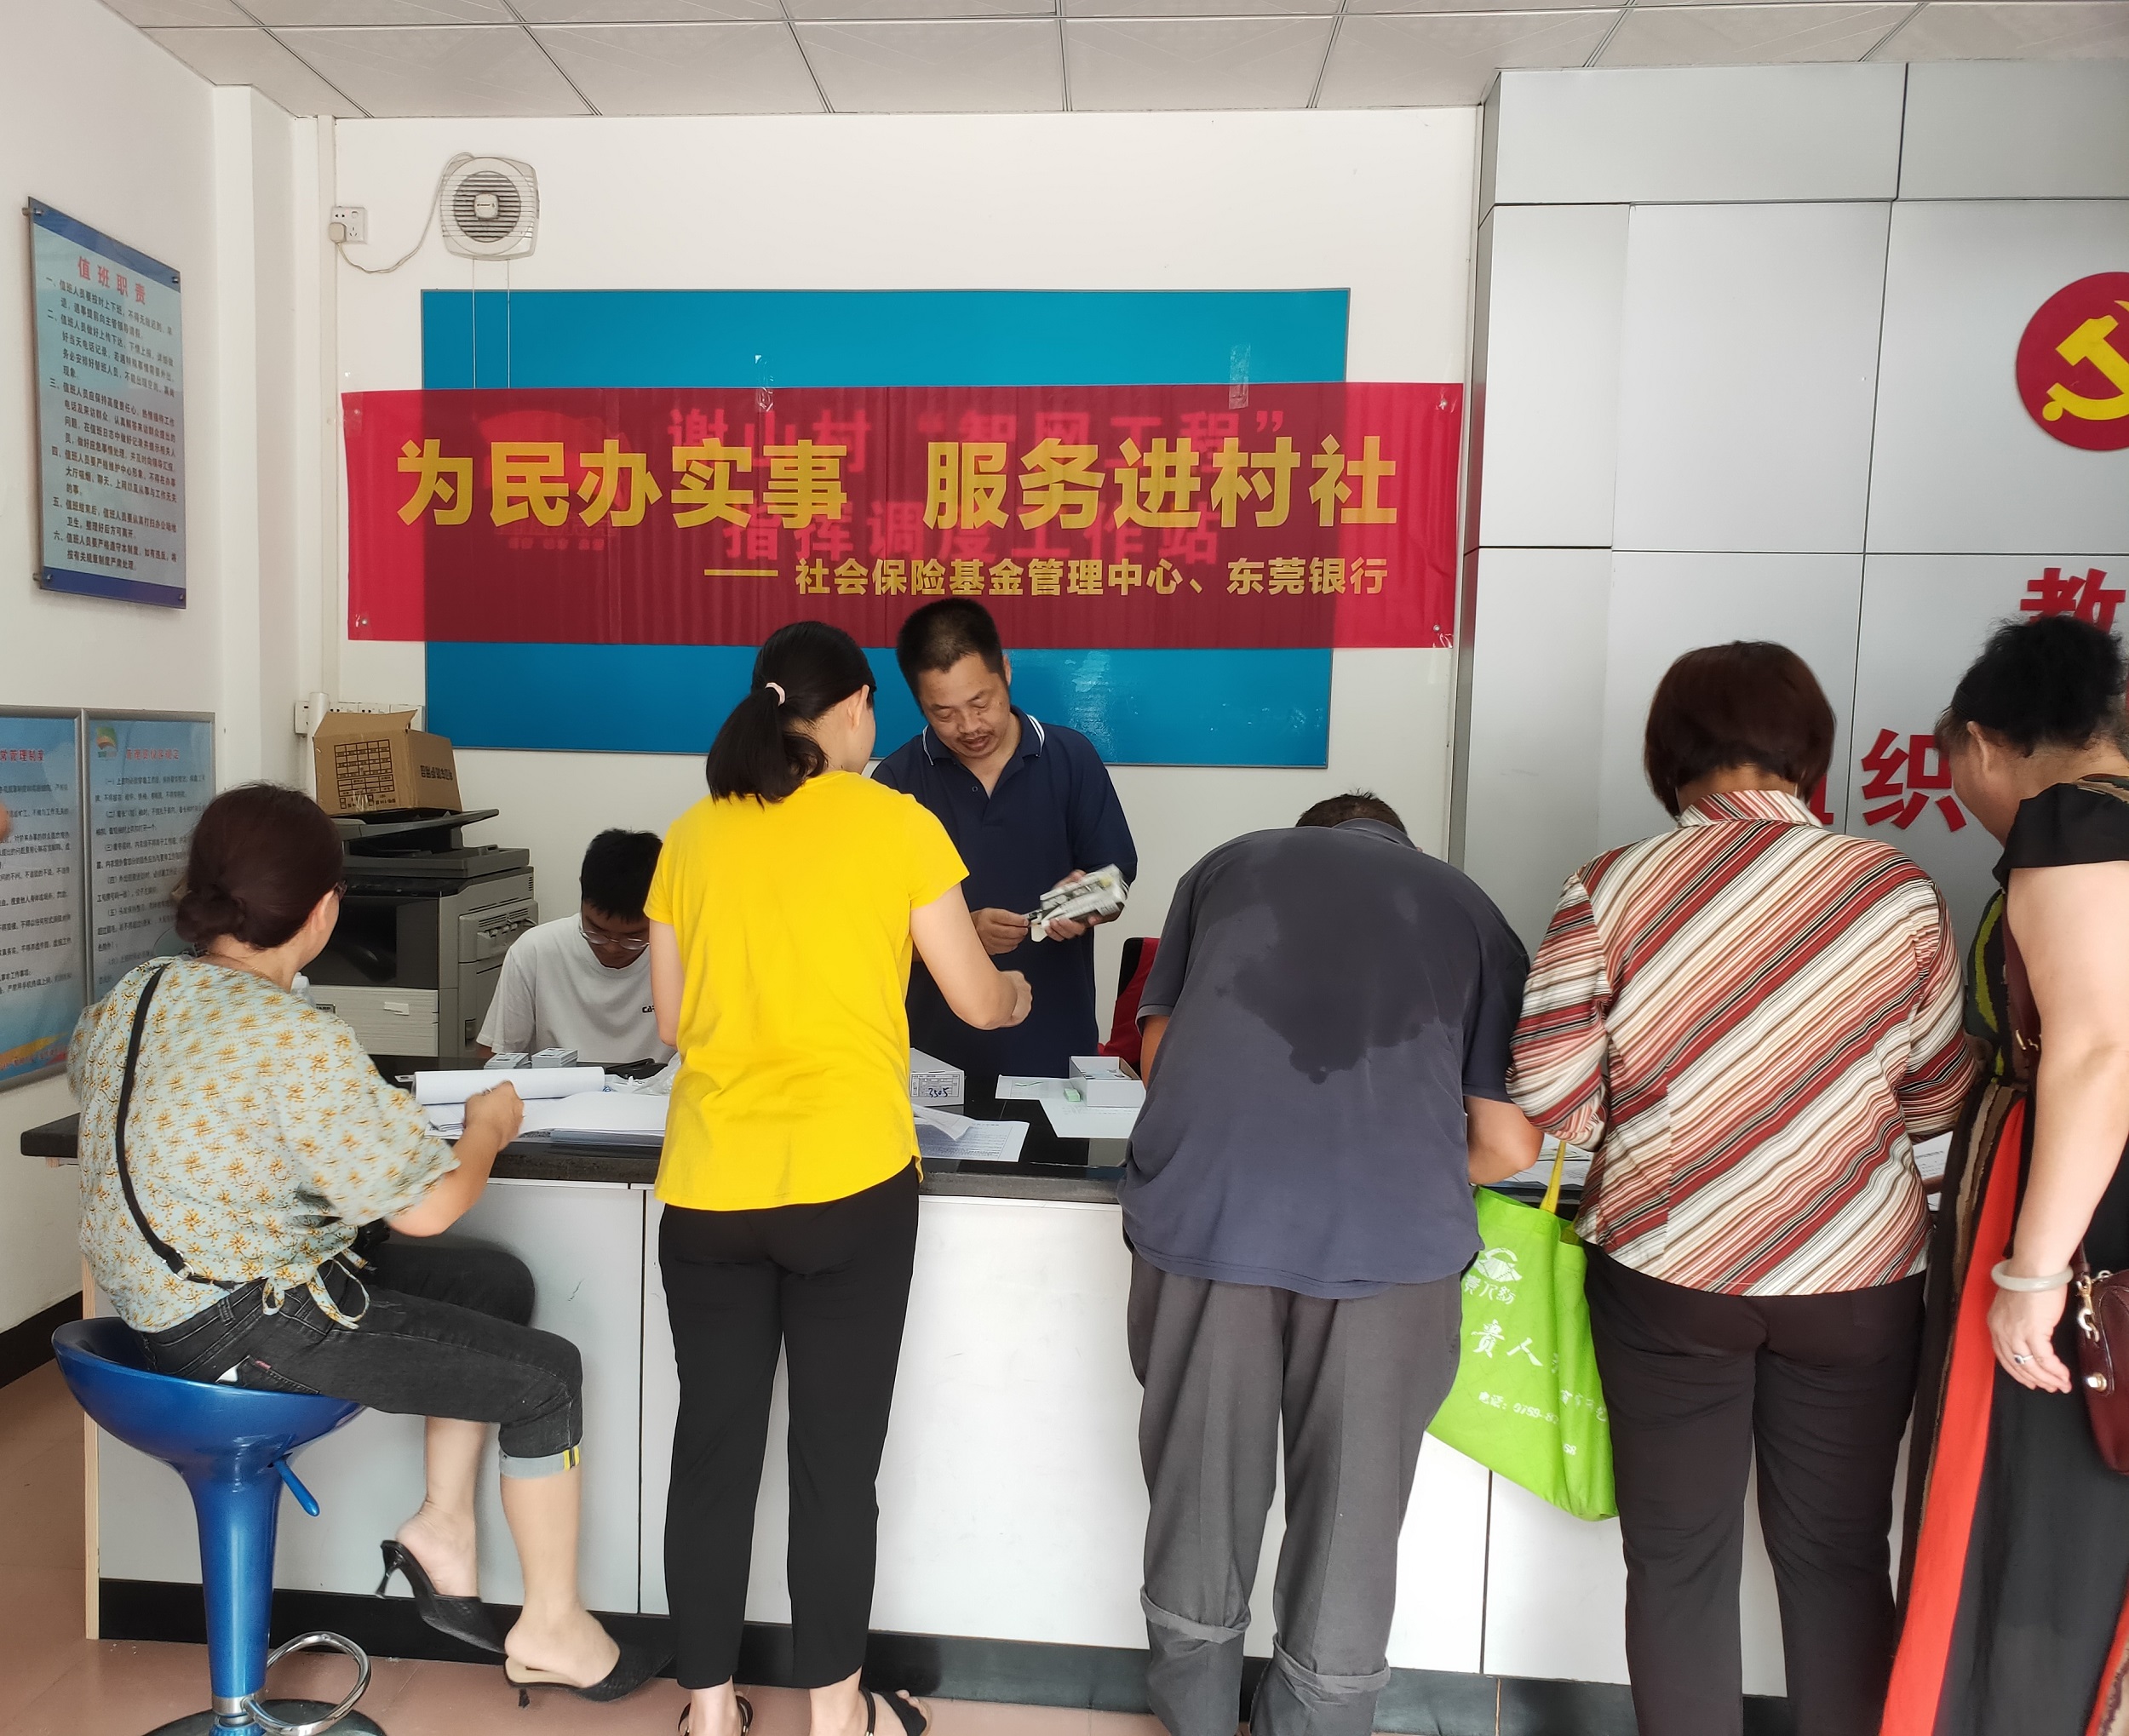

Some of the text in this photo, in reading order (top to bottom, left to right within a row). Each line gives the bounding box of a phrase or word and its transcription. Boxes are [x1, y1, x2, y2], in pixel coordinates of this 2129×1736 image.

[77, 255, 146, 306] 值班职责
[397, 434, 1397, 530] 为民办实事 服务进村社
[795, 558, 1388, 597] 社会保险基金管理中心、东莞银行
[1810, 728, 1967, 832] 织
